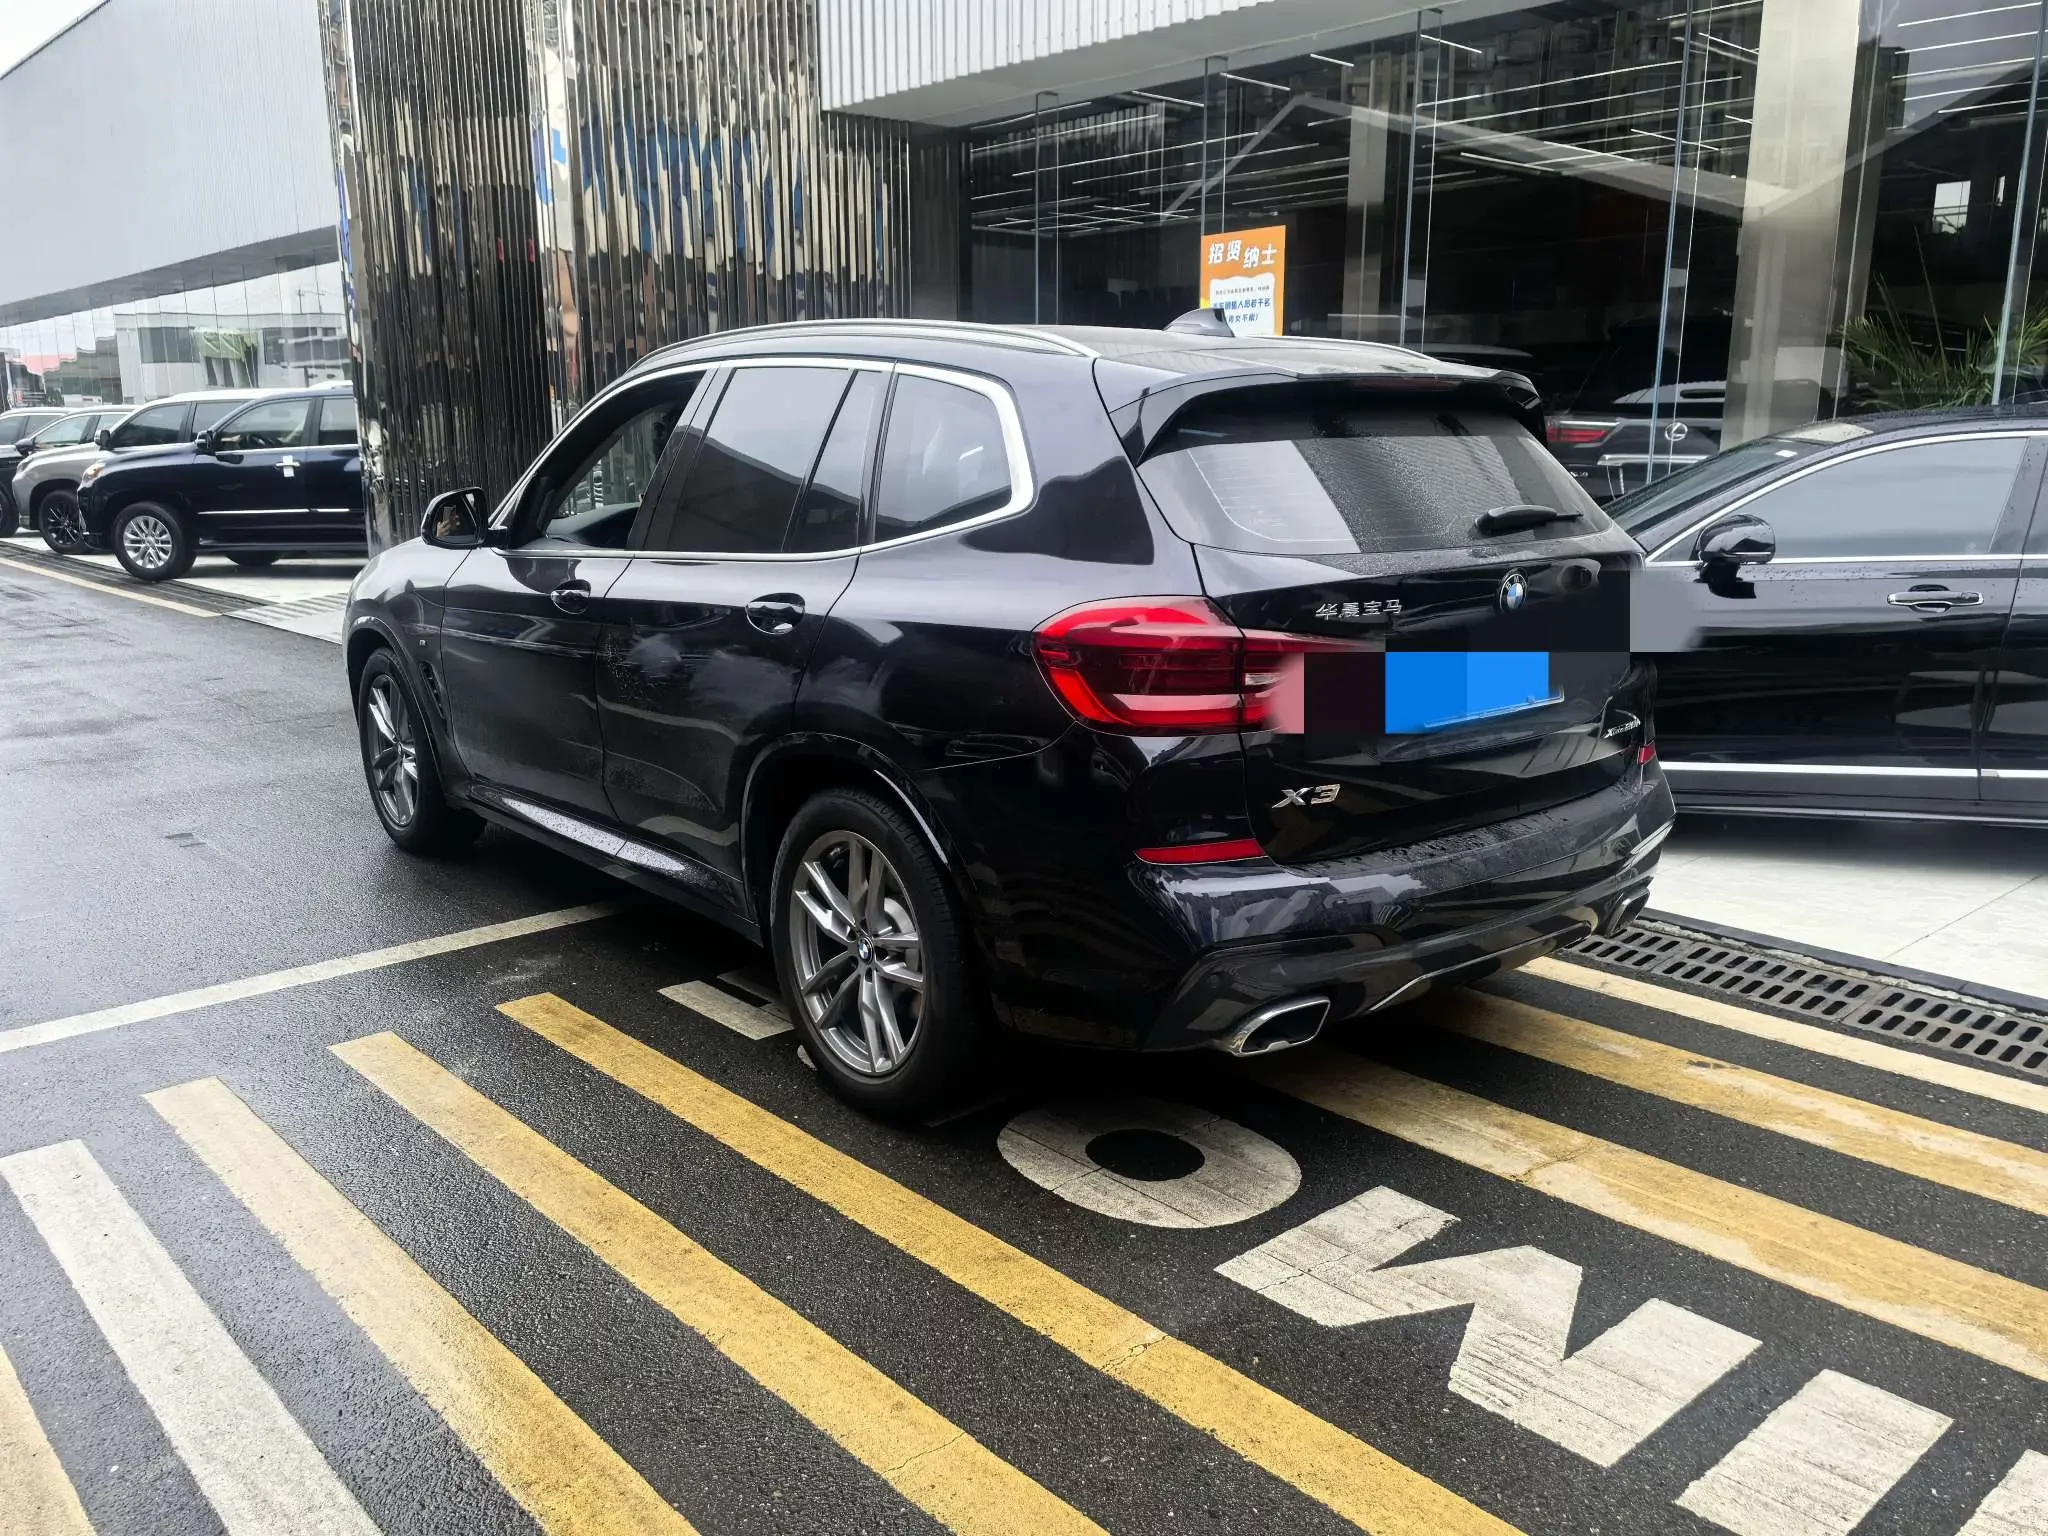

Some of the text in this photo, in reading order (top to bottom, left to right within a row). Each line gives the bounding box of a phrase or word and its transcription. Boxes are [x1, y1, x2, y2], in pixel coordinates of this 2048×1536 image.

[1208, 240, 1278, 268] 招贤纳士
[1315, 599, 1403, 621] 华晨宝马
[1271, 783, 1341, 809] X3
